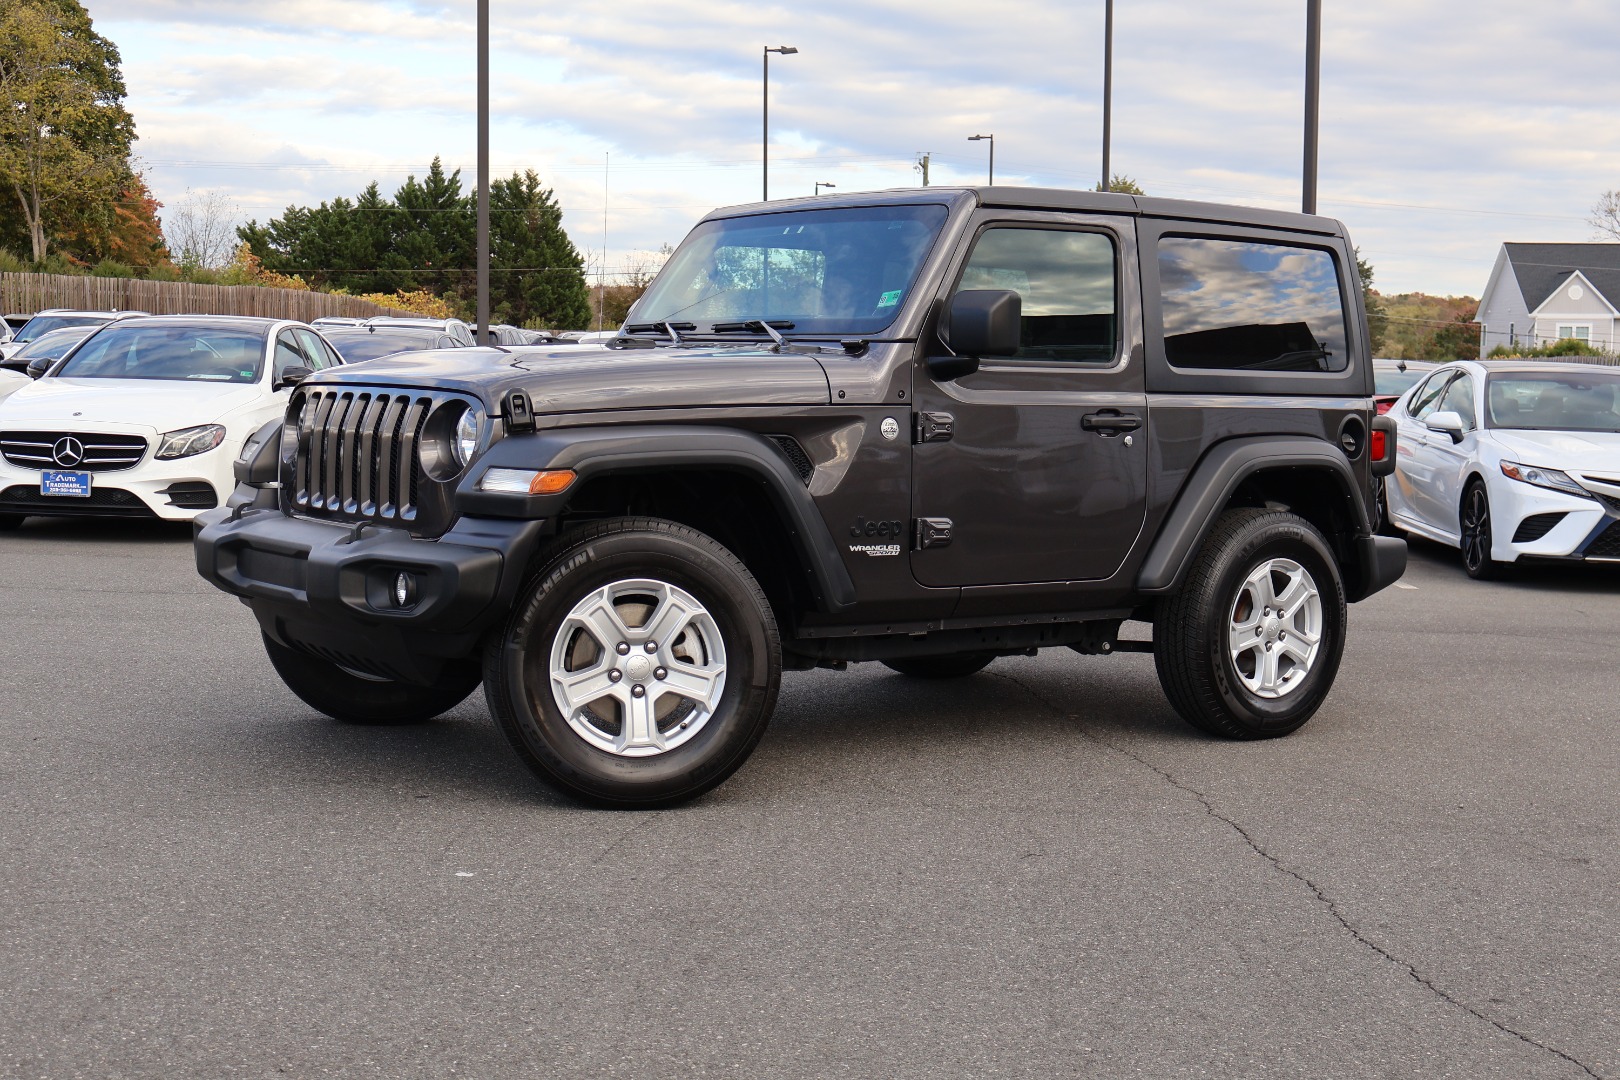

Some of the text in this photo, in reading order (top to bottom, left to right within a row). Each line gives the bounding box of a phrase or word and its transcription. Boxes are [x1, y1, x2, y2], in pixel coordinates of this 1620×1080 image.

[56, 474, 76, 482] AUTO
[850, 515, 902, 540] Jeep
[849, 544, 901, 552] WRANGLER
[523, 550, 588, 622] MICHELIN
